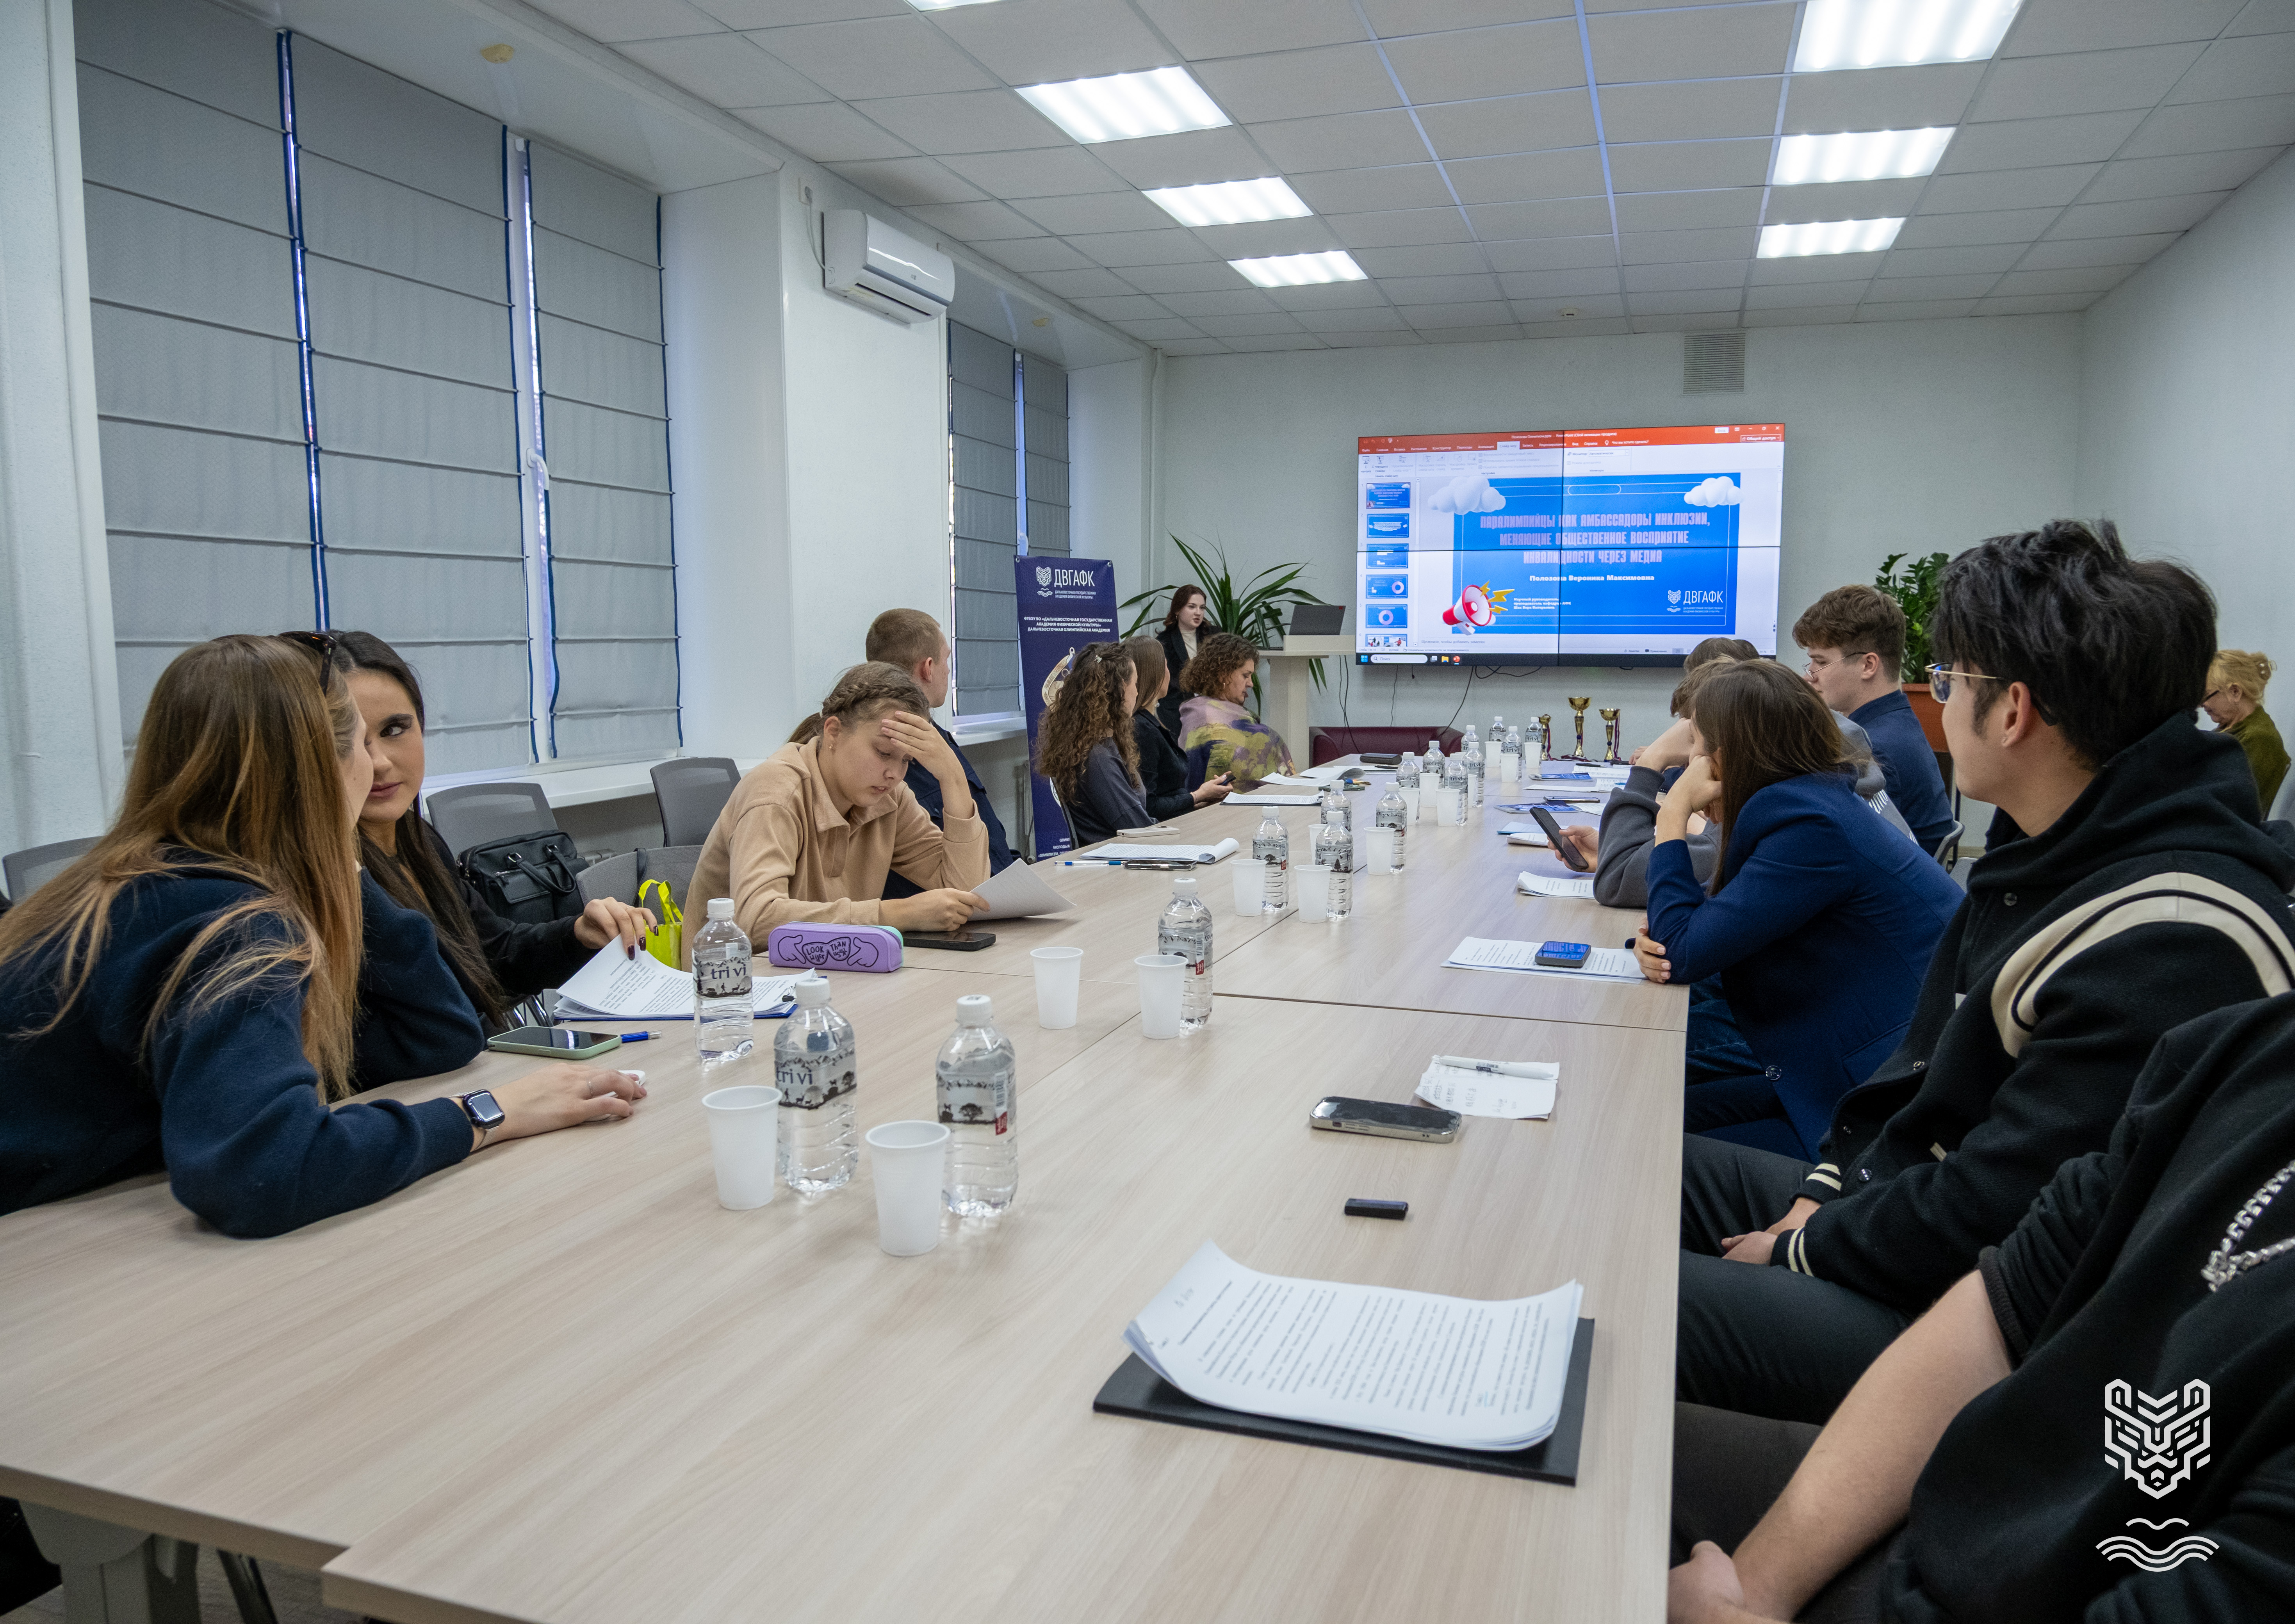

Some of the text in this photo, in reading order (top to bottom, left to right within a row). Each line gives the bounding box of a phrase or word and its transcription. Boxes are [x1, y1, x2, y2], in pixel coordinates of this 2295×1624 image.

[1480, 512, 1710, 529] ПАРАЛИМПИЙЦЫ КАК АМБАССАДОРЫ ИНКЛЮЗИИ,
[1500, 531, 1689, 546] МЕНЯЮЩИЕ ОБЩЕСТВЕННОЕ ВОСПРИЯТИЕ
[1523, 550, 1662, 564] ИНВАЛИДНОСТИ ЧЕРЕЗ МЕДИА
[1054, 569, 1095, 588] ДВГАФК
[1683, 590, 1723, 605] ДВГАФК
[806, 946, 825, 955] LOOK
[711, 963, 747, 980] tri vi
[775, 1067, 813, 1085] tri vi
